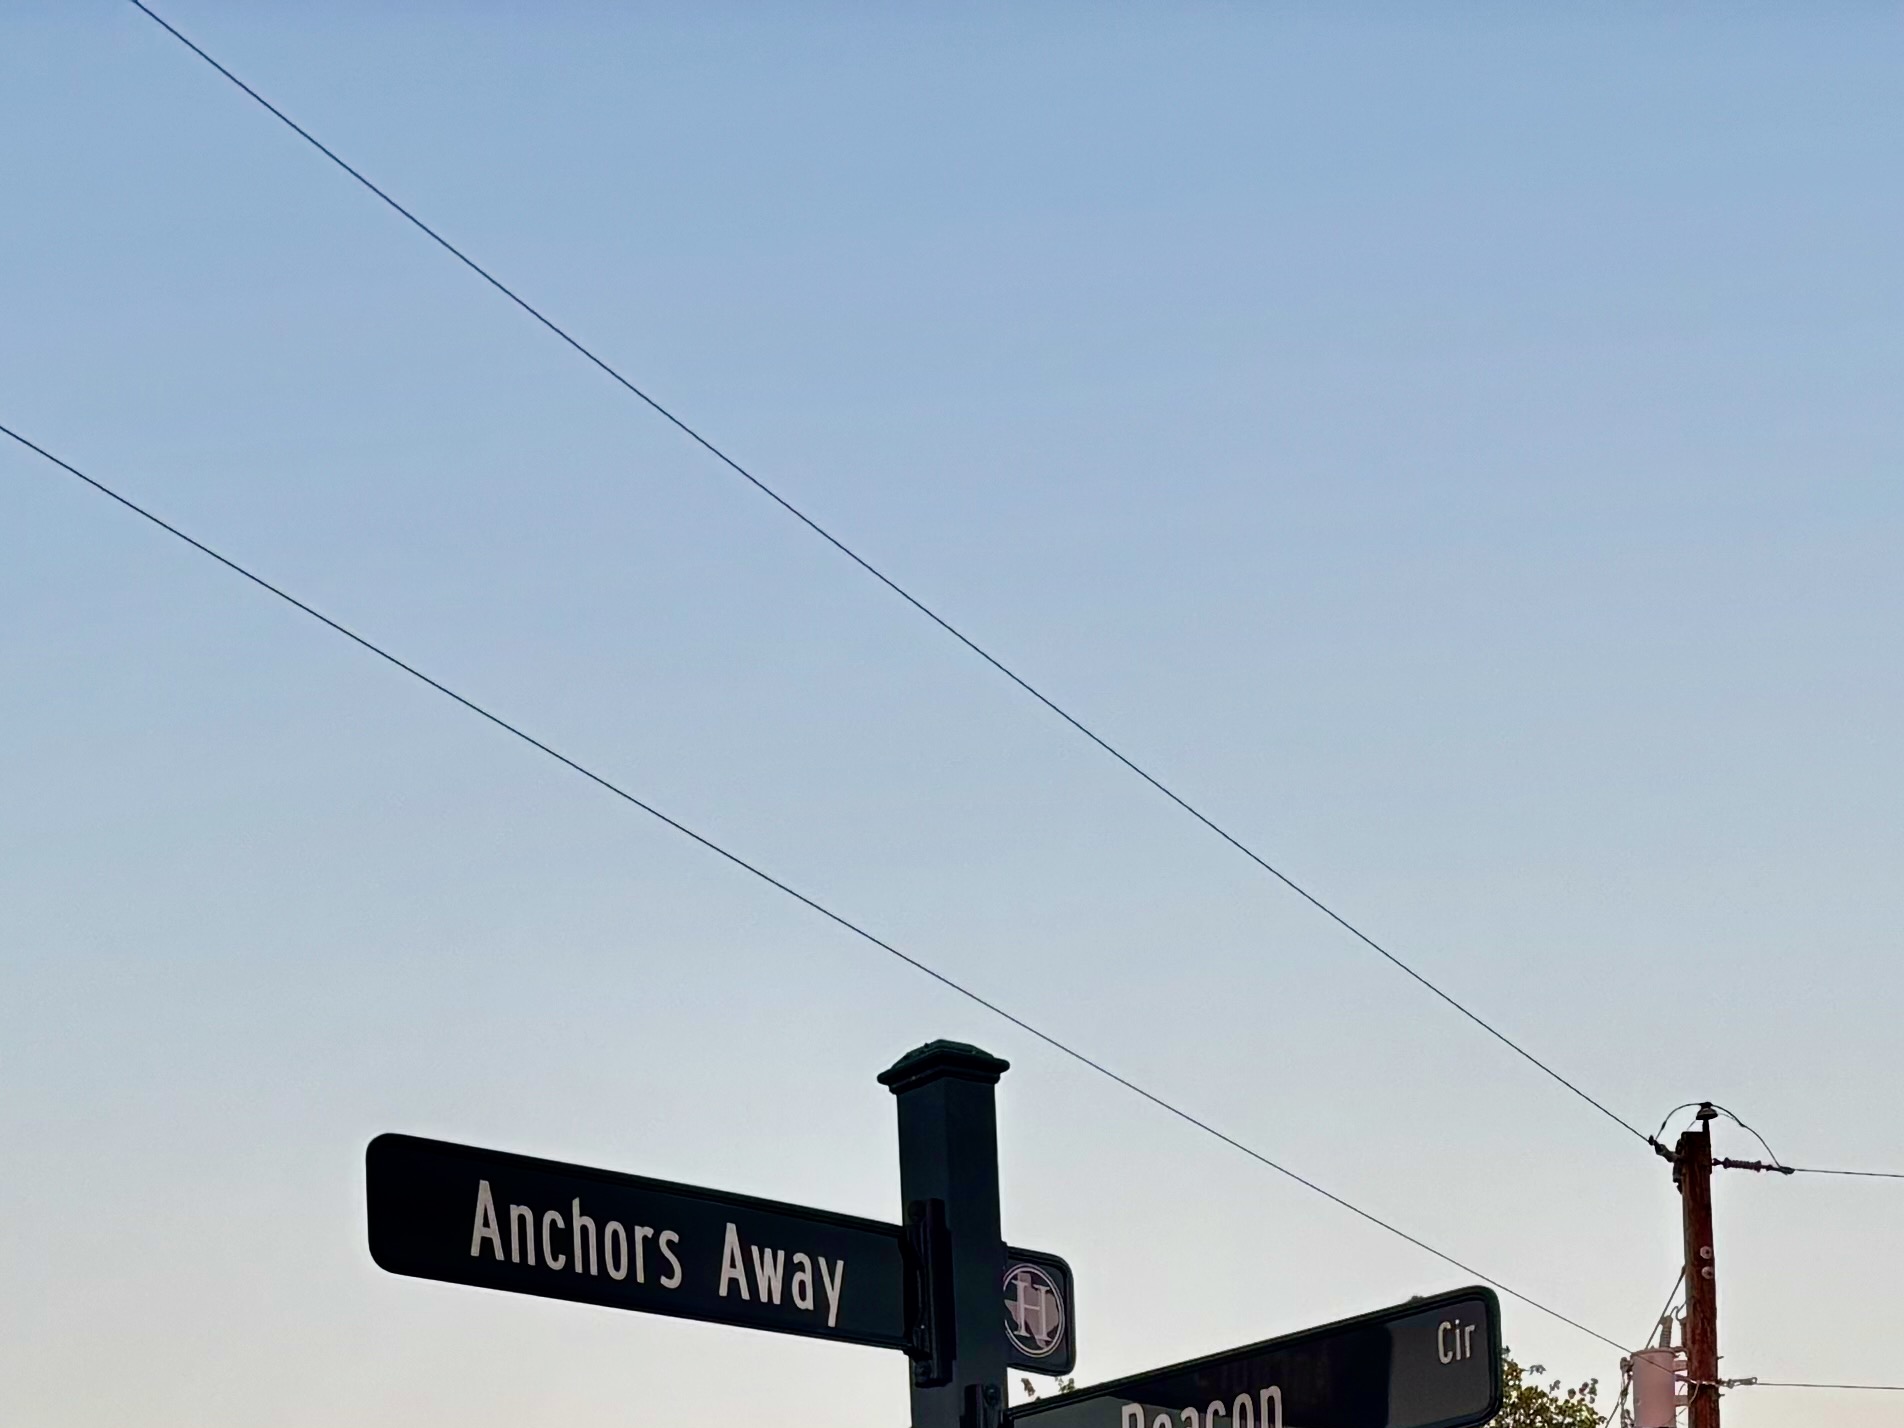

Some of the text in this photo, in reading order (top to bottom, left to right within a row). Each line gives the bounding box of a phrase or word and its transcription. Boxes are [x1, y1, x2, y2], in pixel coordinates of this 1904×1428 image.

[470, 1179, 845, 1328] Anchors Away
[1437, 1319, 1476, 1365] Cir
